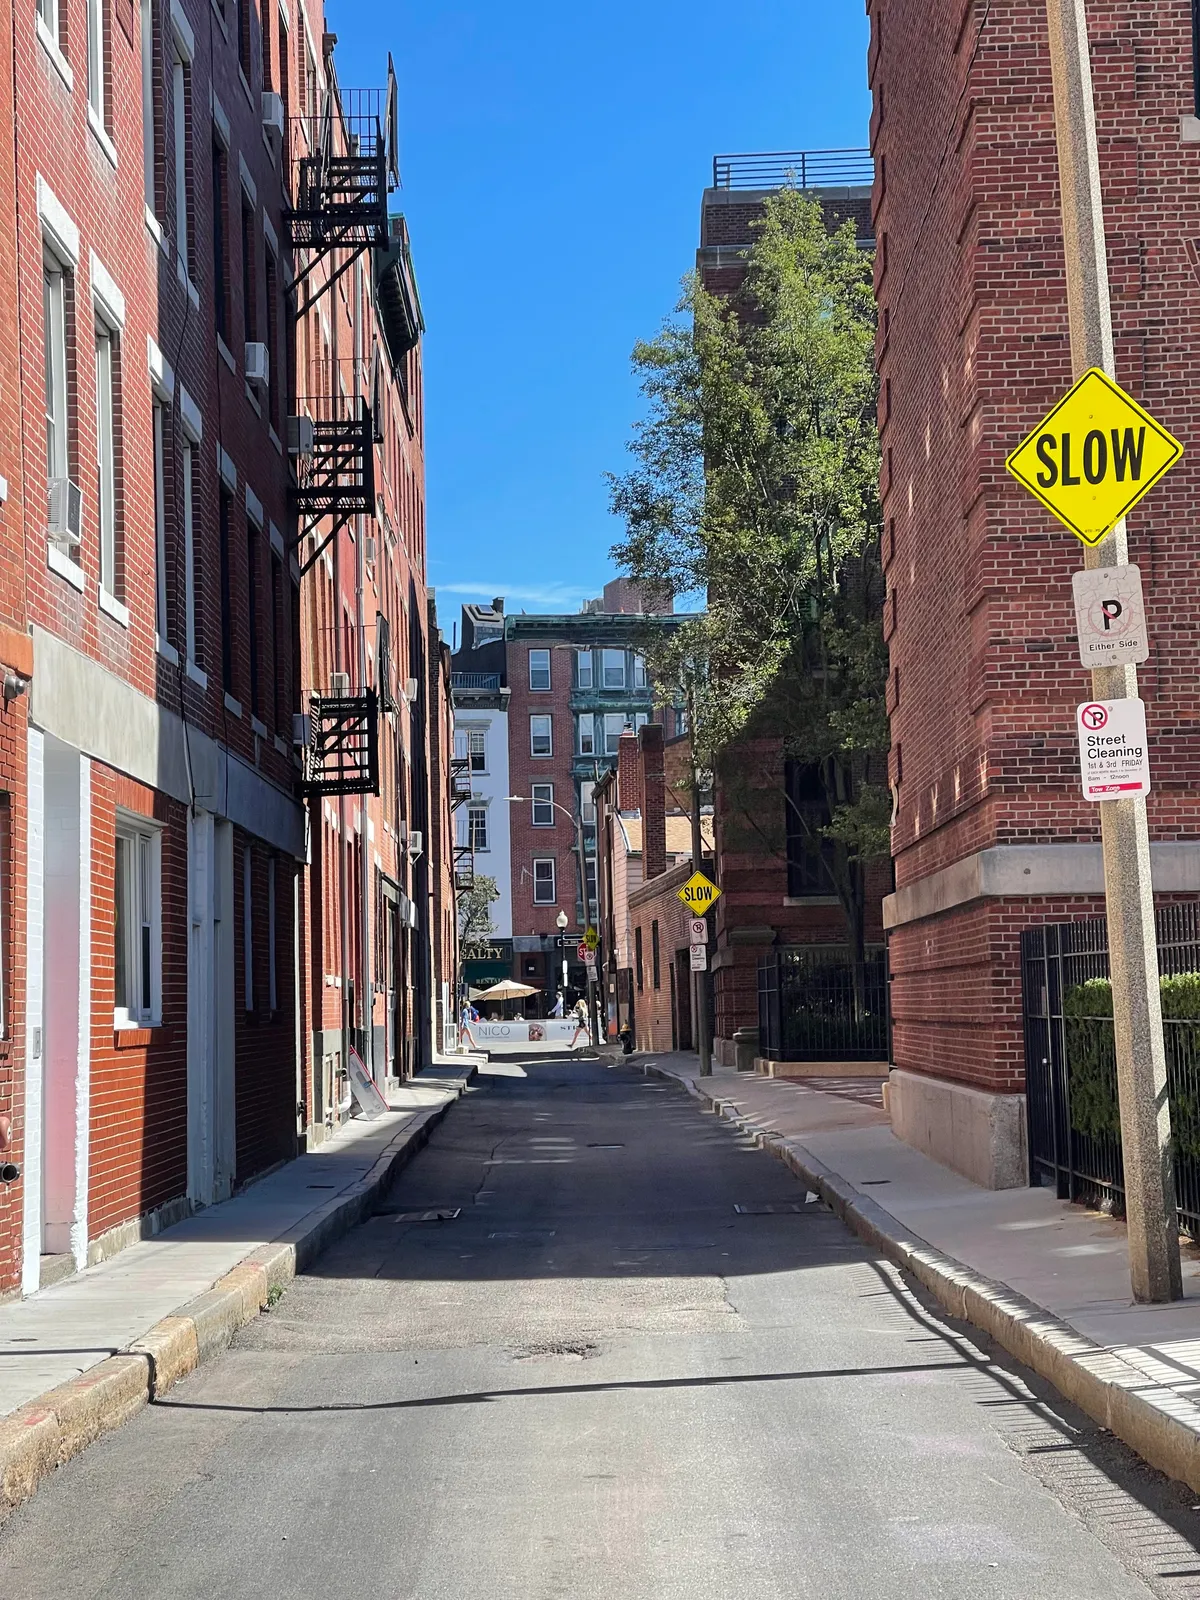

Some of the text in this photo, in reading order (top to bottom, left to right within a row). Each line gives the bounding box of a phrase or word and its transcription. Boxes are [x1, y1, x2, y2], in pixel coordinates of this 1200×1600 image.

[1036, 426, 1146, 489] SLOW
[1089, 640, 1138, 652] Either Side
[1087, 734, 1126, 747] Street
[1087, 746, 1142, 759] Cleaning
[1121, 759, 1143, 767] FRIDAY
[684, 886, 713, 902] SLOW
[461, 948, 504, 960] EALTY
[479, 1026, 511, 1036] NICO
